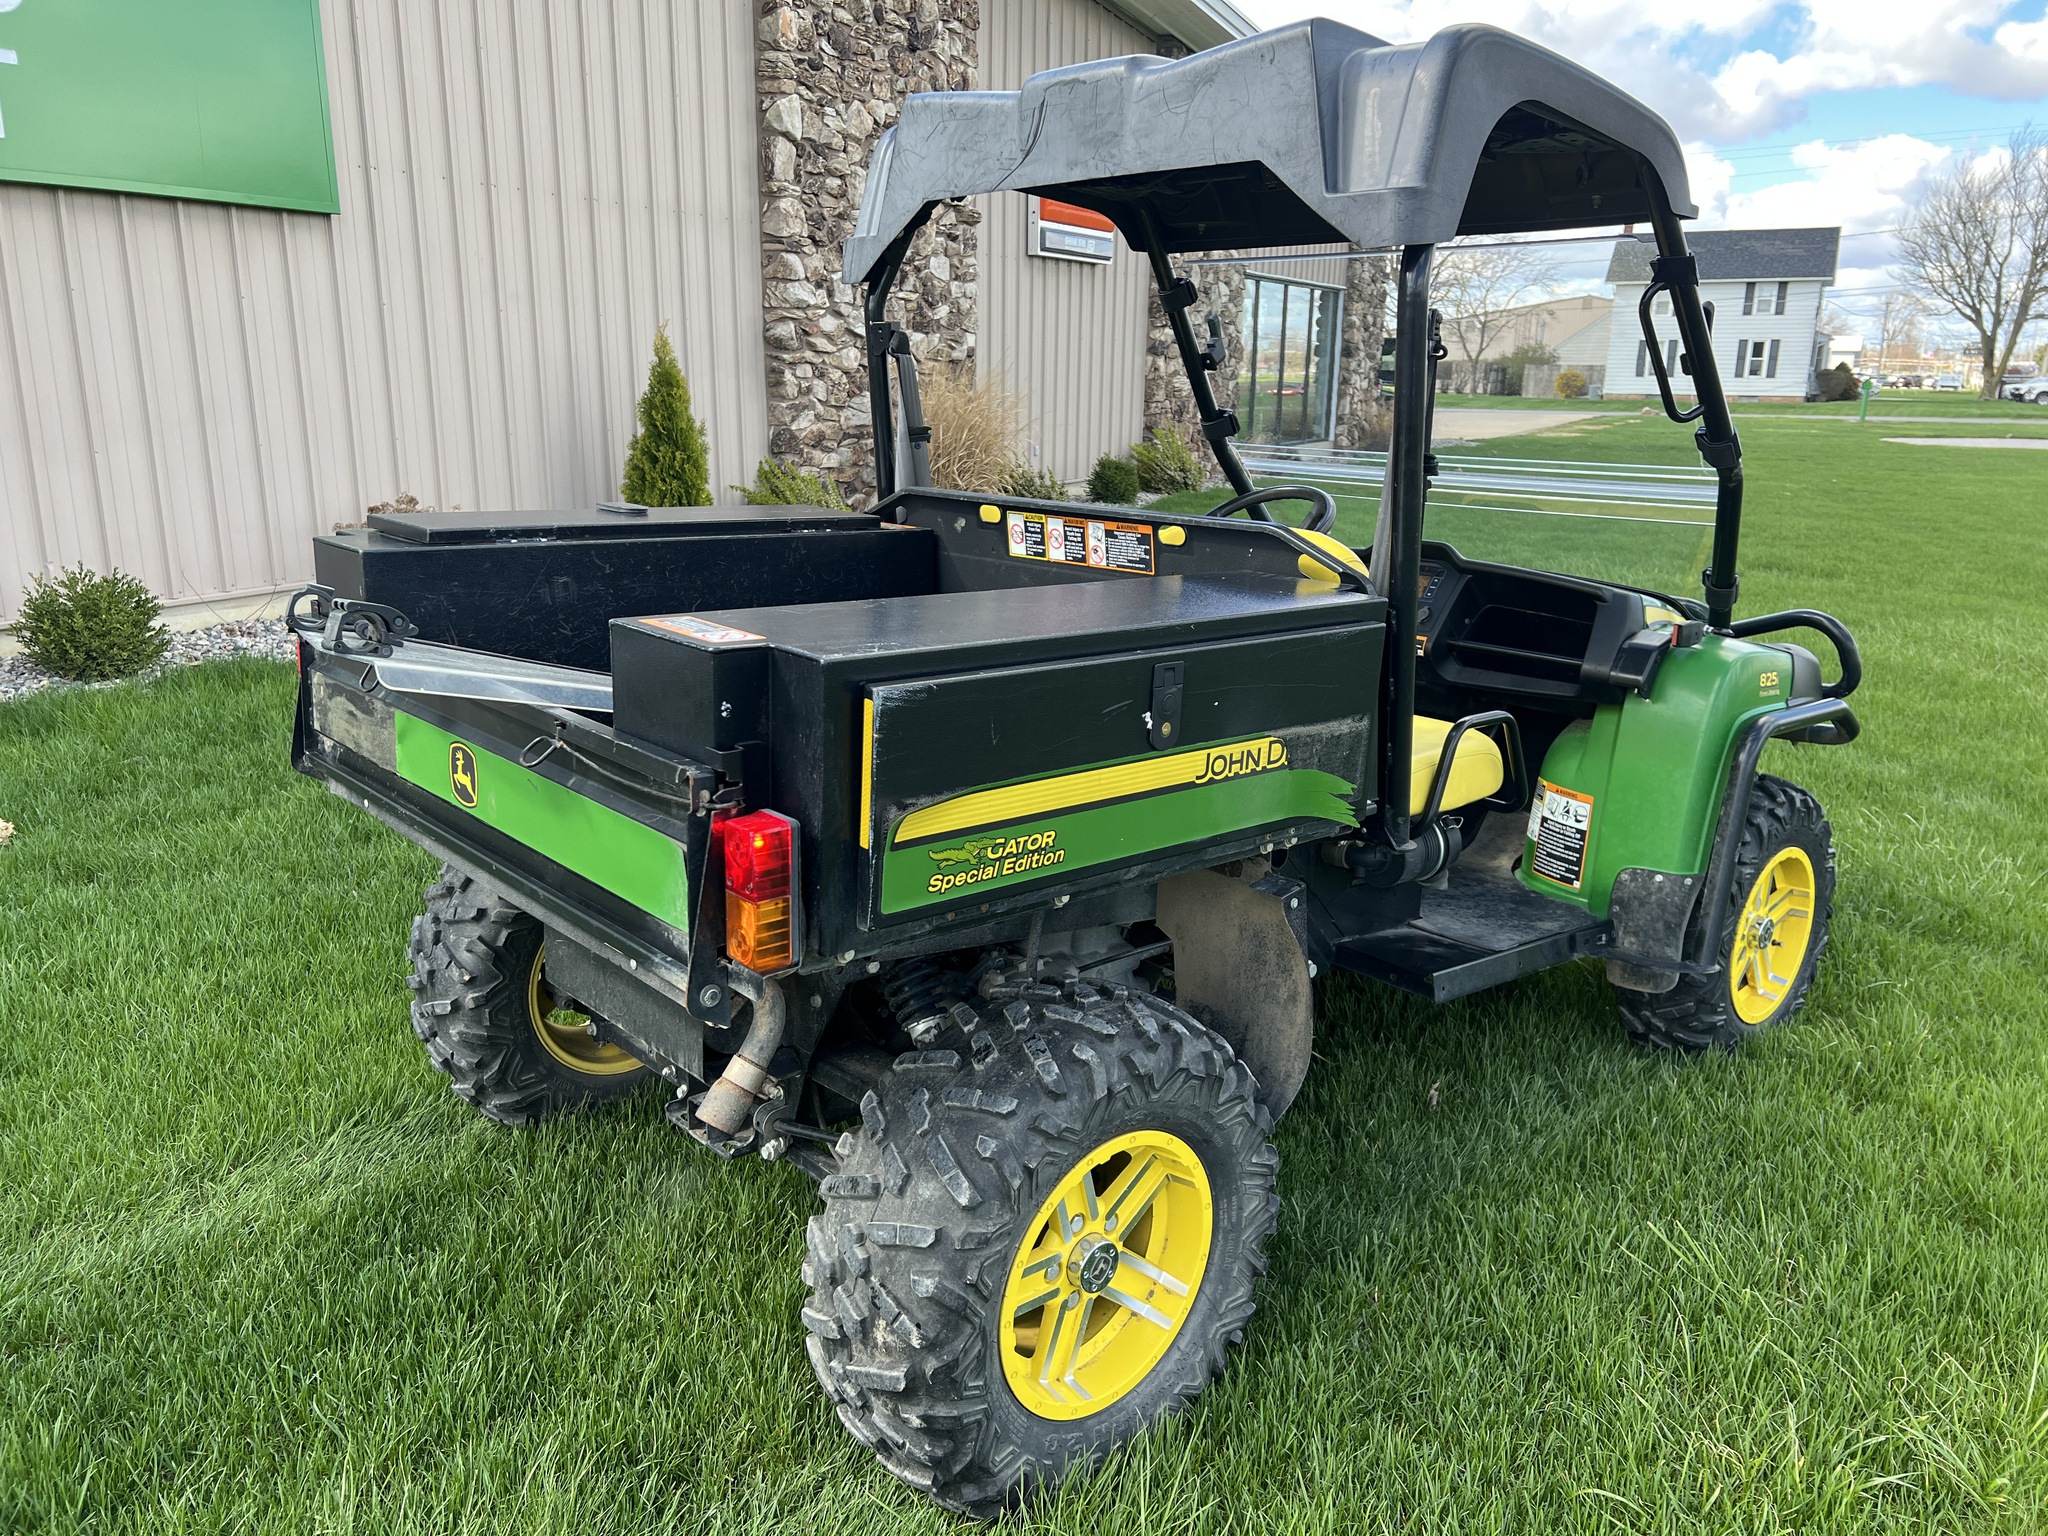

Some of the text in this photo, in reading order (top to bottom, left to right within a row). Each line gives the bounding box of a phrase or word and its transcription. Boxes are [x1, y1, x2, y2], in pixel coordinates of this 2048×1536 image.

[1195, 739, 1288, 783] JOHN D
[1560, 789, 1578, 799] WARNING
[986, 829, 1057, 860] GATOR
[927, 848, 1066, 895] Special Edition
